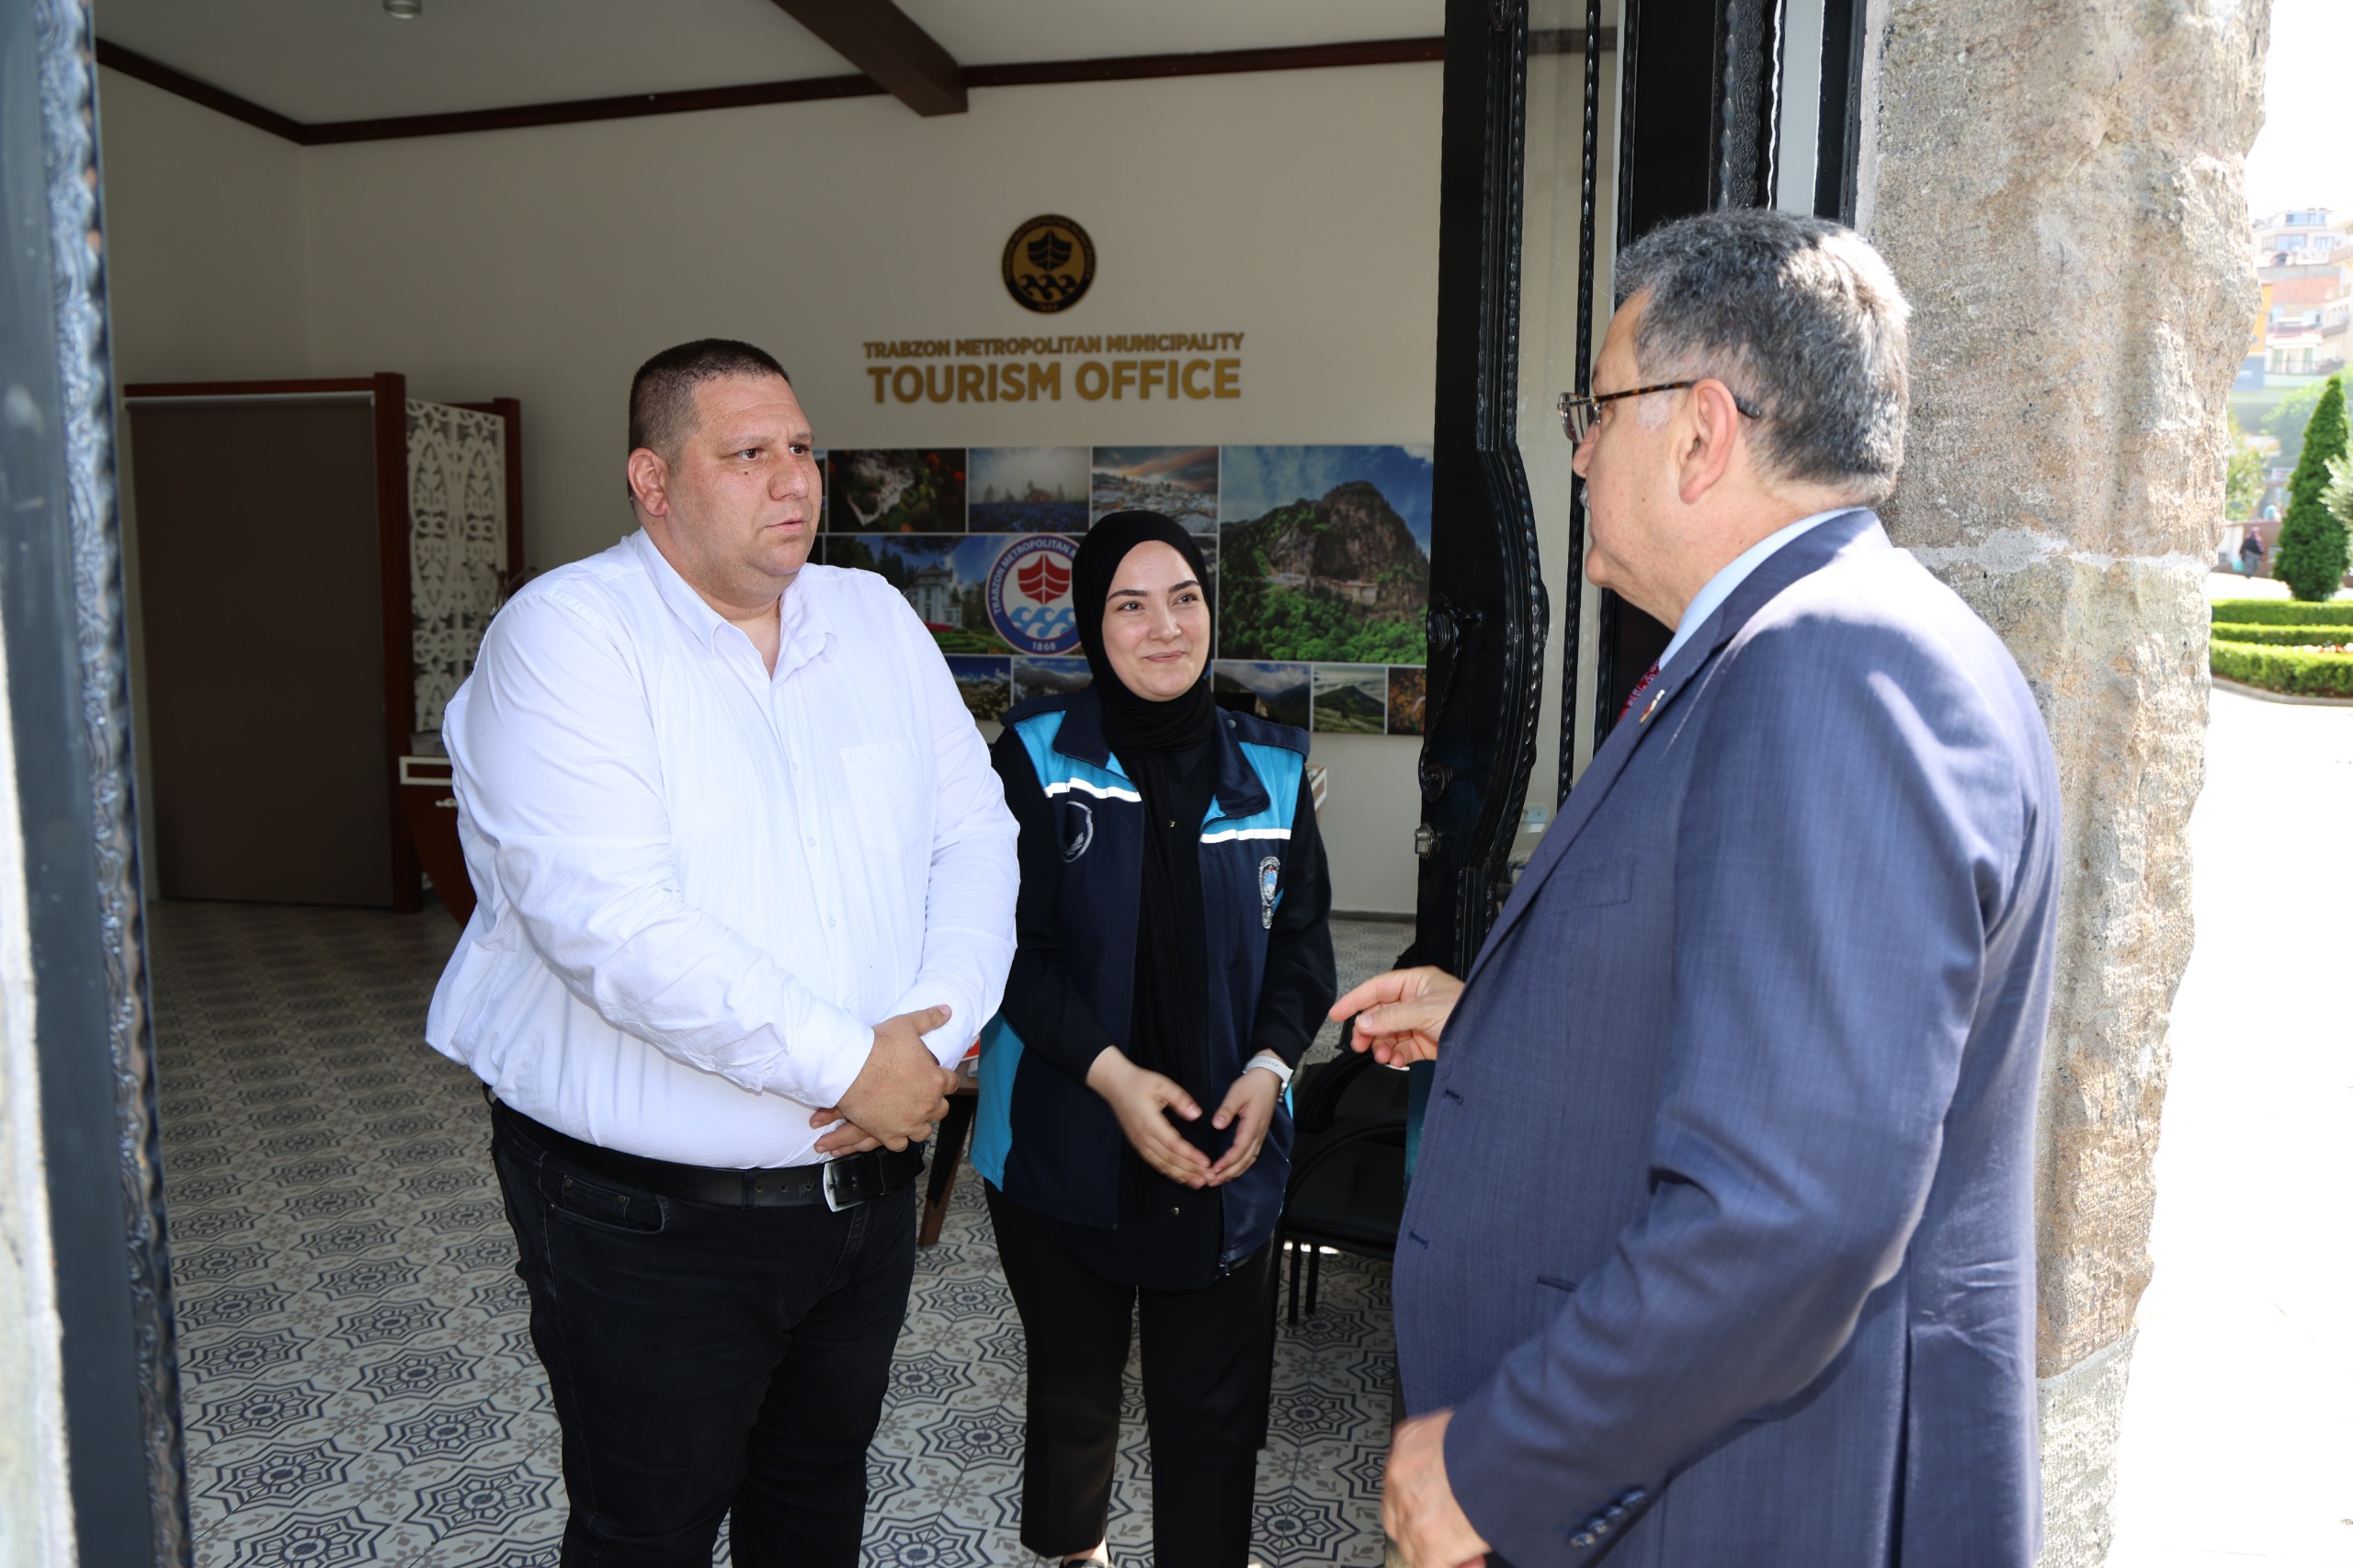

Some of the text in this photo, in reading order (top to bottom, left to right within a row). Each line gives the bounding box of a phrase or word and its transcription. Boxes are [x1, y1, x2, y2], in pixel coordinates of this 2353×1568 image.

[863, 332, 1245, 358] TRABZON METROPOLITAN MUNICIPALITY
[867, 358, 1241, 404] TOURISM OFFICE
[991, 539, 1070, 614] TRABZON METROPOLITAN
[1032, 642, 1056, 651] 1868
